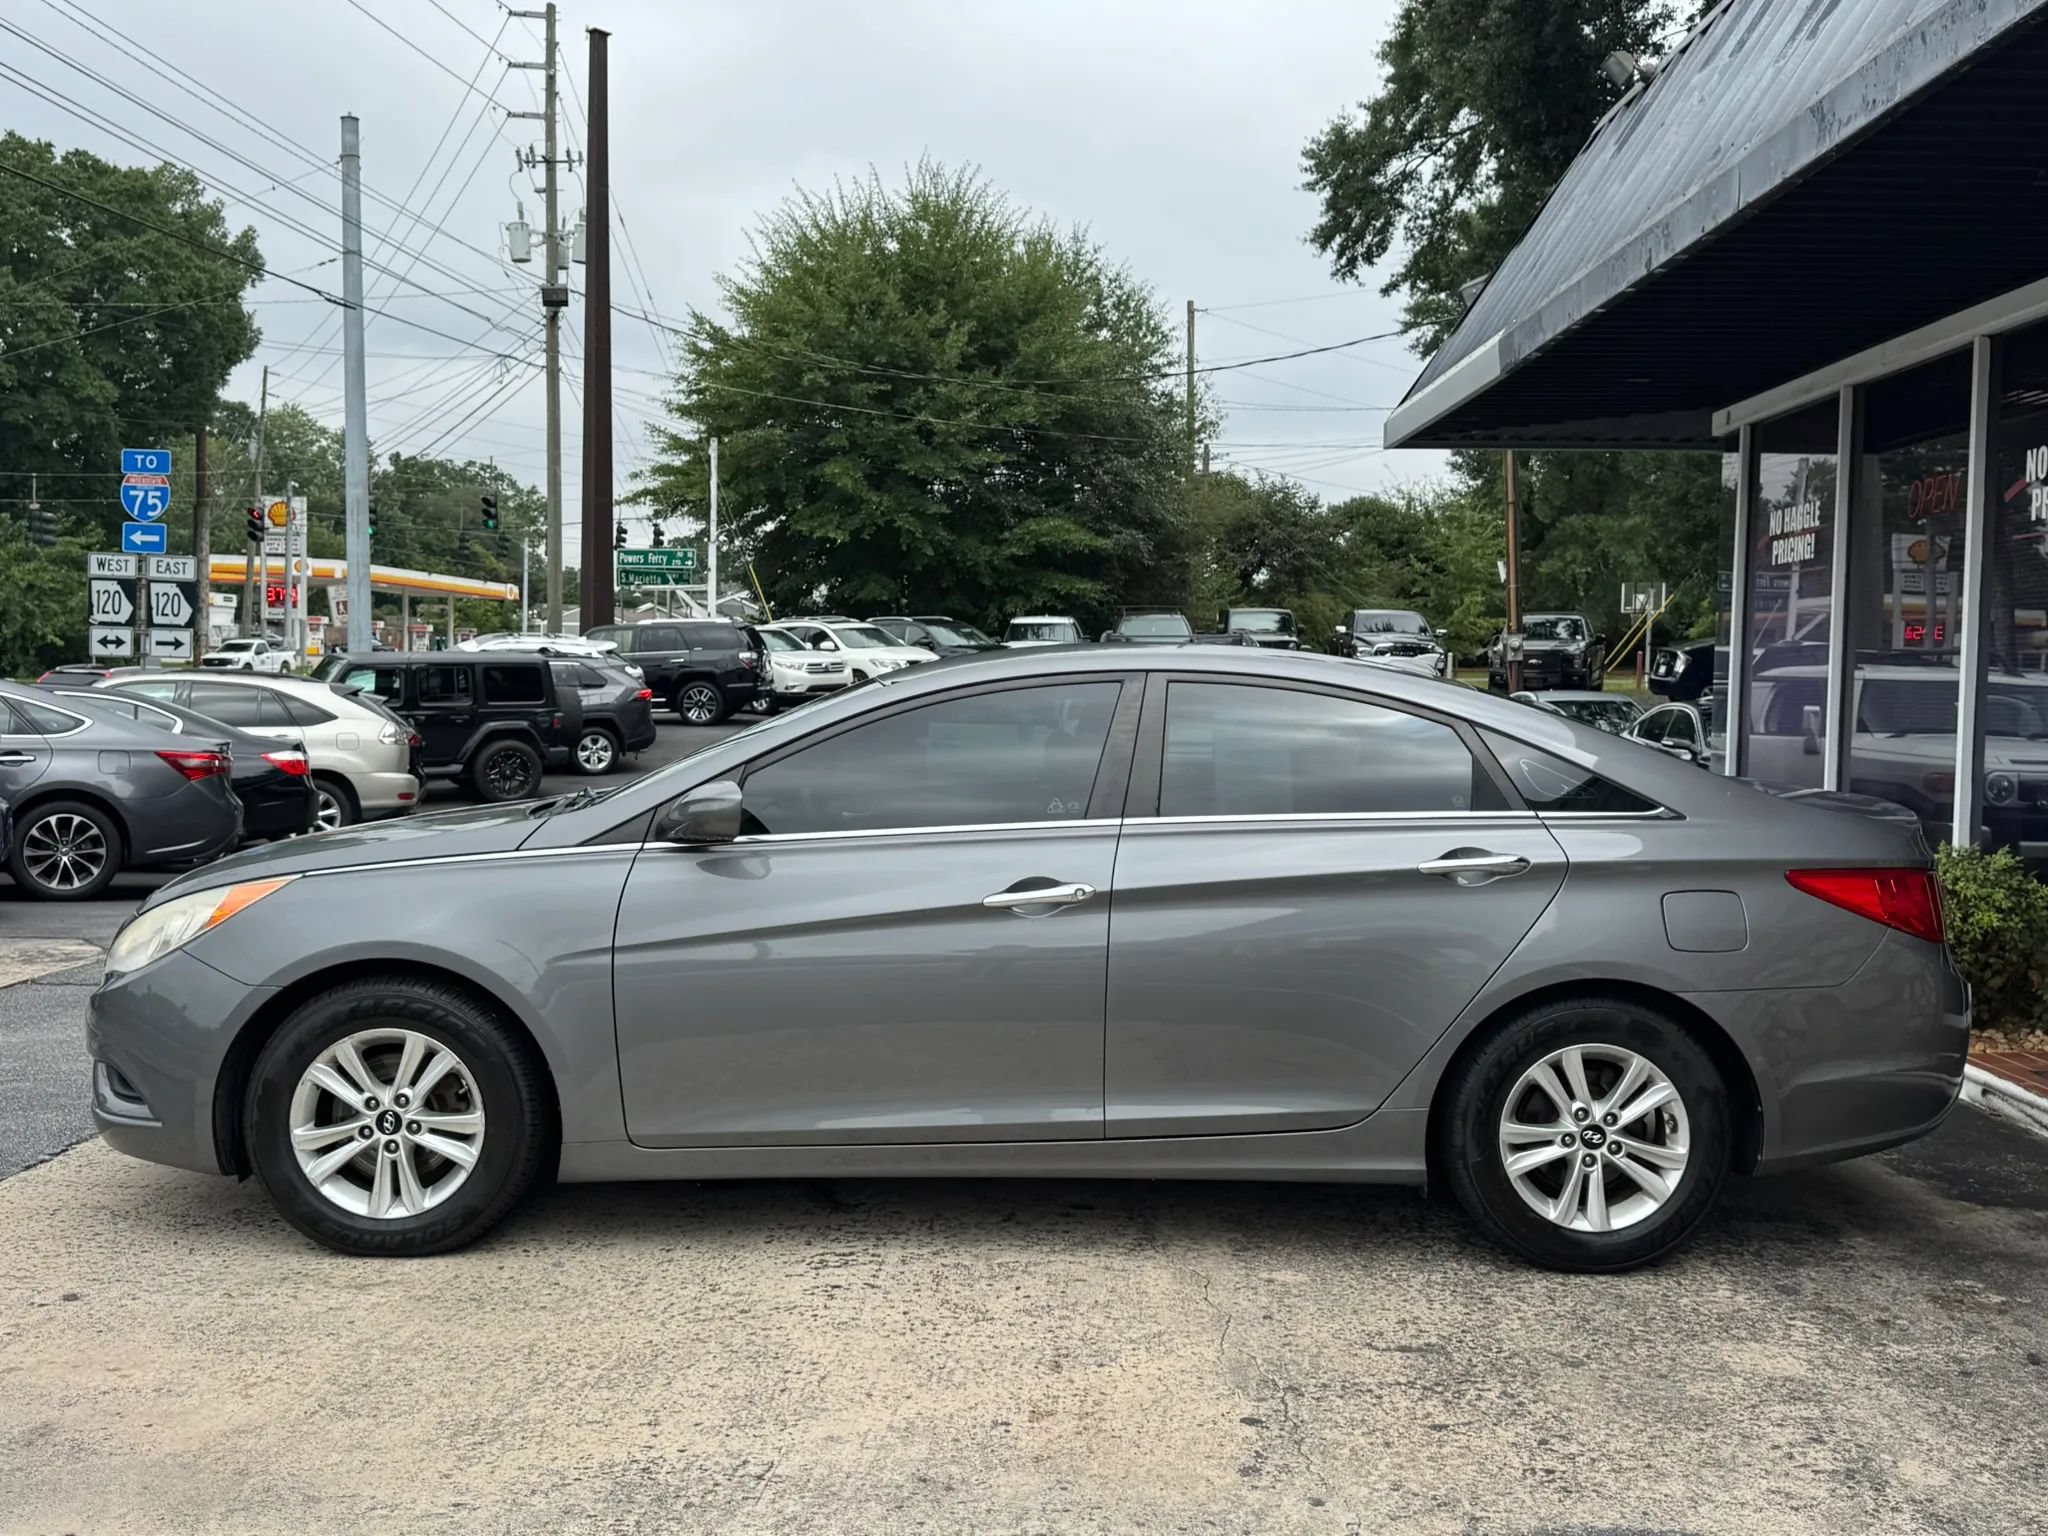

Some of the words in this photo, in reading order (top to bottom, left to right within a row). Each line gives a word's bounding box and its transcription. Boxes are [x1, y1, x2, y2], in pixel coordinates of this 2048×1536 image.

[134, 454, 158, 469] TO
[2026, 445, 2048, 482] NO
[129, 490, 162, 517] 75
[1907, 473, 1961, 518] OPEN
[1769, 509, 1783, 537] NO
[1784, 500, 1821, 533] HAGGLE
[619, 552, 645, 564] Powers
[648, 553, 667, 566] Ferry
[1771, 532, 1816, 566] PRICING!
[96, 556, 131, 573] WEST
[156, 559, 188, 575] EAST
[96, 589, 122, 616] 120
[155, 592, 181, 618] 120
